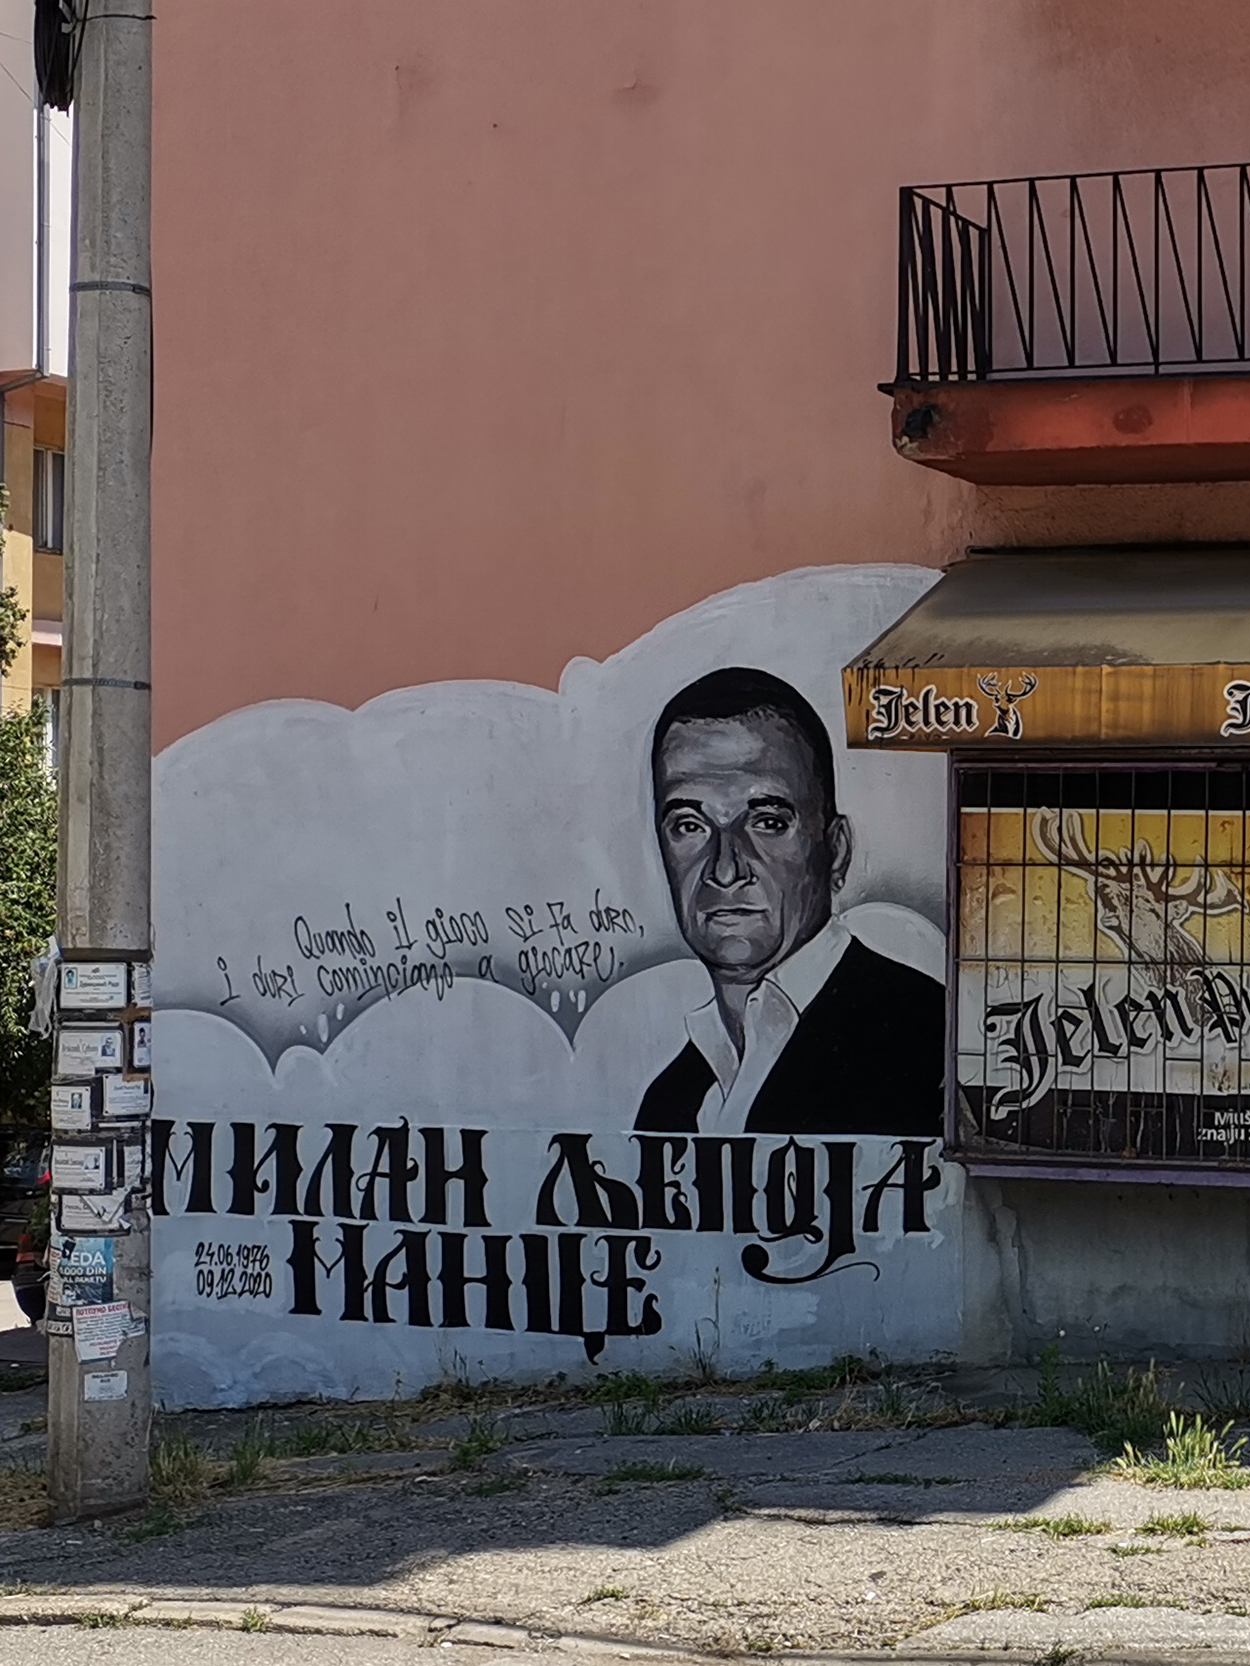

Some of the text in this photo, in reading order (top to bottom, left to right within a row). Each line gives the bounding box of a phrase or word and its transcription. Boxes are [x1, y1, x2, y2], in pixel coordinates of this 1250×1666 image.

[868, 685, 979, 740] Jelen
[294, 902, 375, 960] Quando
[425, 908, 489, 961] gioco
[317, 954, 453, 1002] cominciano
[478, 954, 499, 983] a
[981, 980, 1199, 1121] Jelen
[1197, 1124, 1245, 1145] znaju
[151, 1116, 942, 1285] МИЛАН ЉЕПОЈА
[86, 1266, 107, 1276] DIN
[194, 1241, 270, 1272] 24.06.1976
[196, 1267, 273, 1301] 09.12.2020
[286, 1217, 663, 1366] МАНЦЕ
